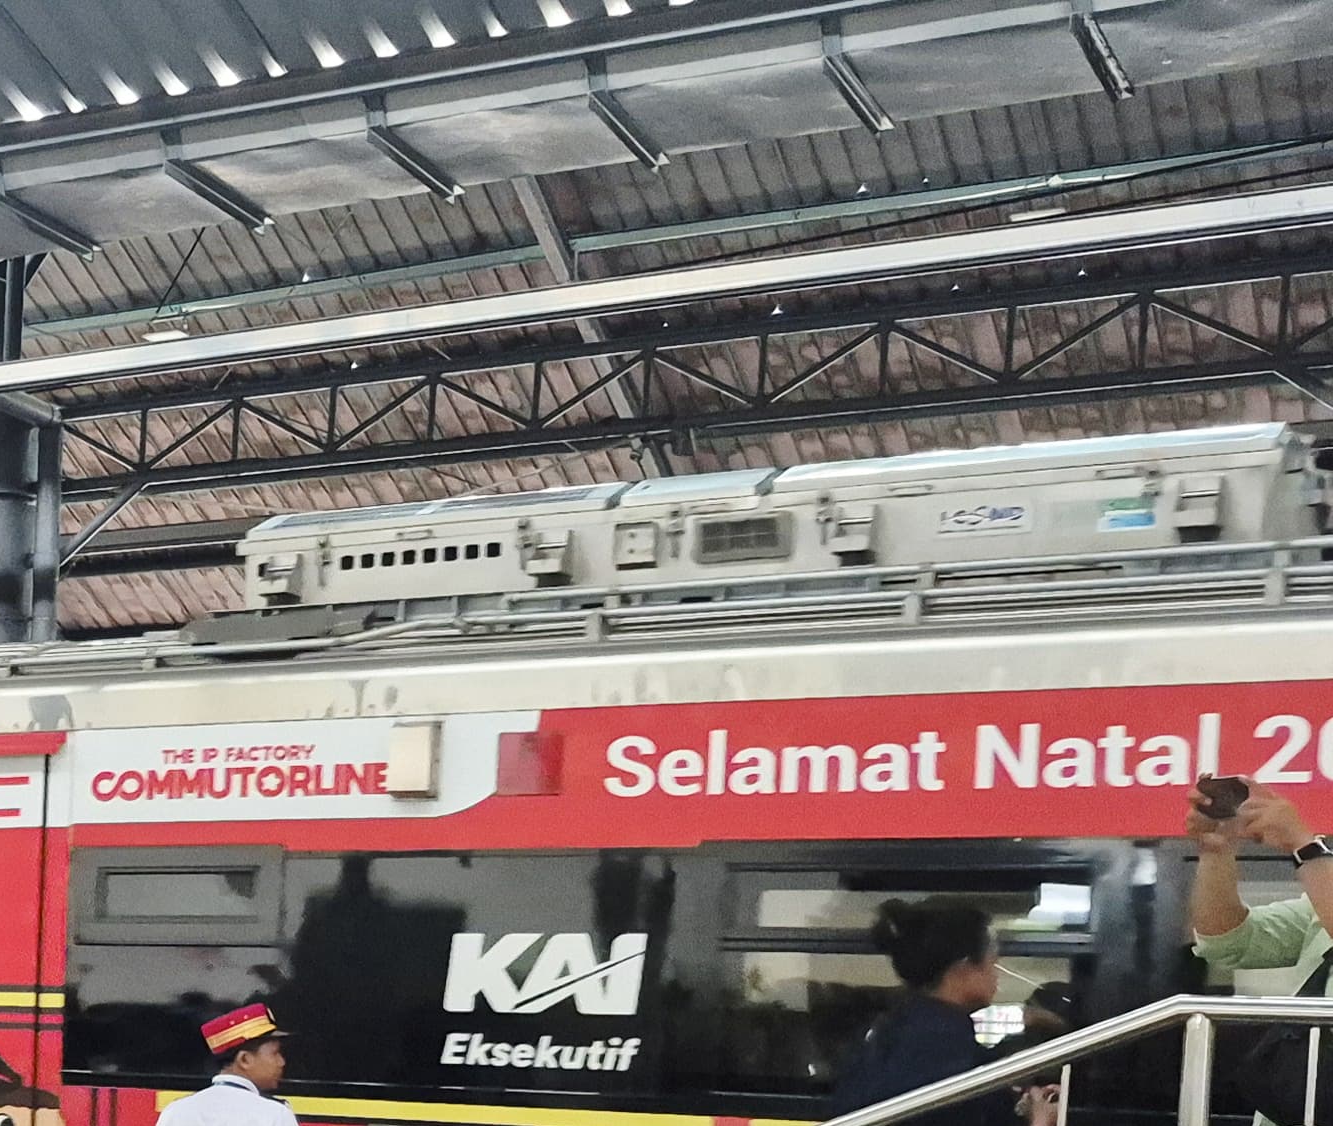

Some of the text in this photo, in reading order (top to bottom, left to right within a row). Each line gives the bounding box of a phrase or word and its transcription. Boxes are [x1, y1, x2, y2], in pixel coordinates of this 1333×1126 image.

[162, 744, 316, 764] THE IP FACTORY
[603, 712, 1333, 798] Selamat Natal 2
[91, 761, 389, 802] COMMUTORLINE
[442, 932, 649, 1016] KAI
[439, 1032, 642, 1072] Eksekutif
